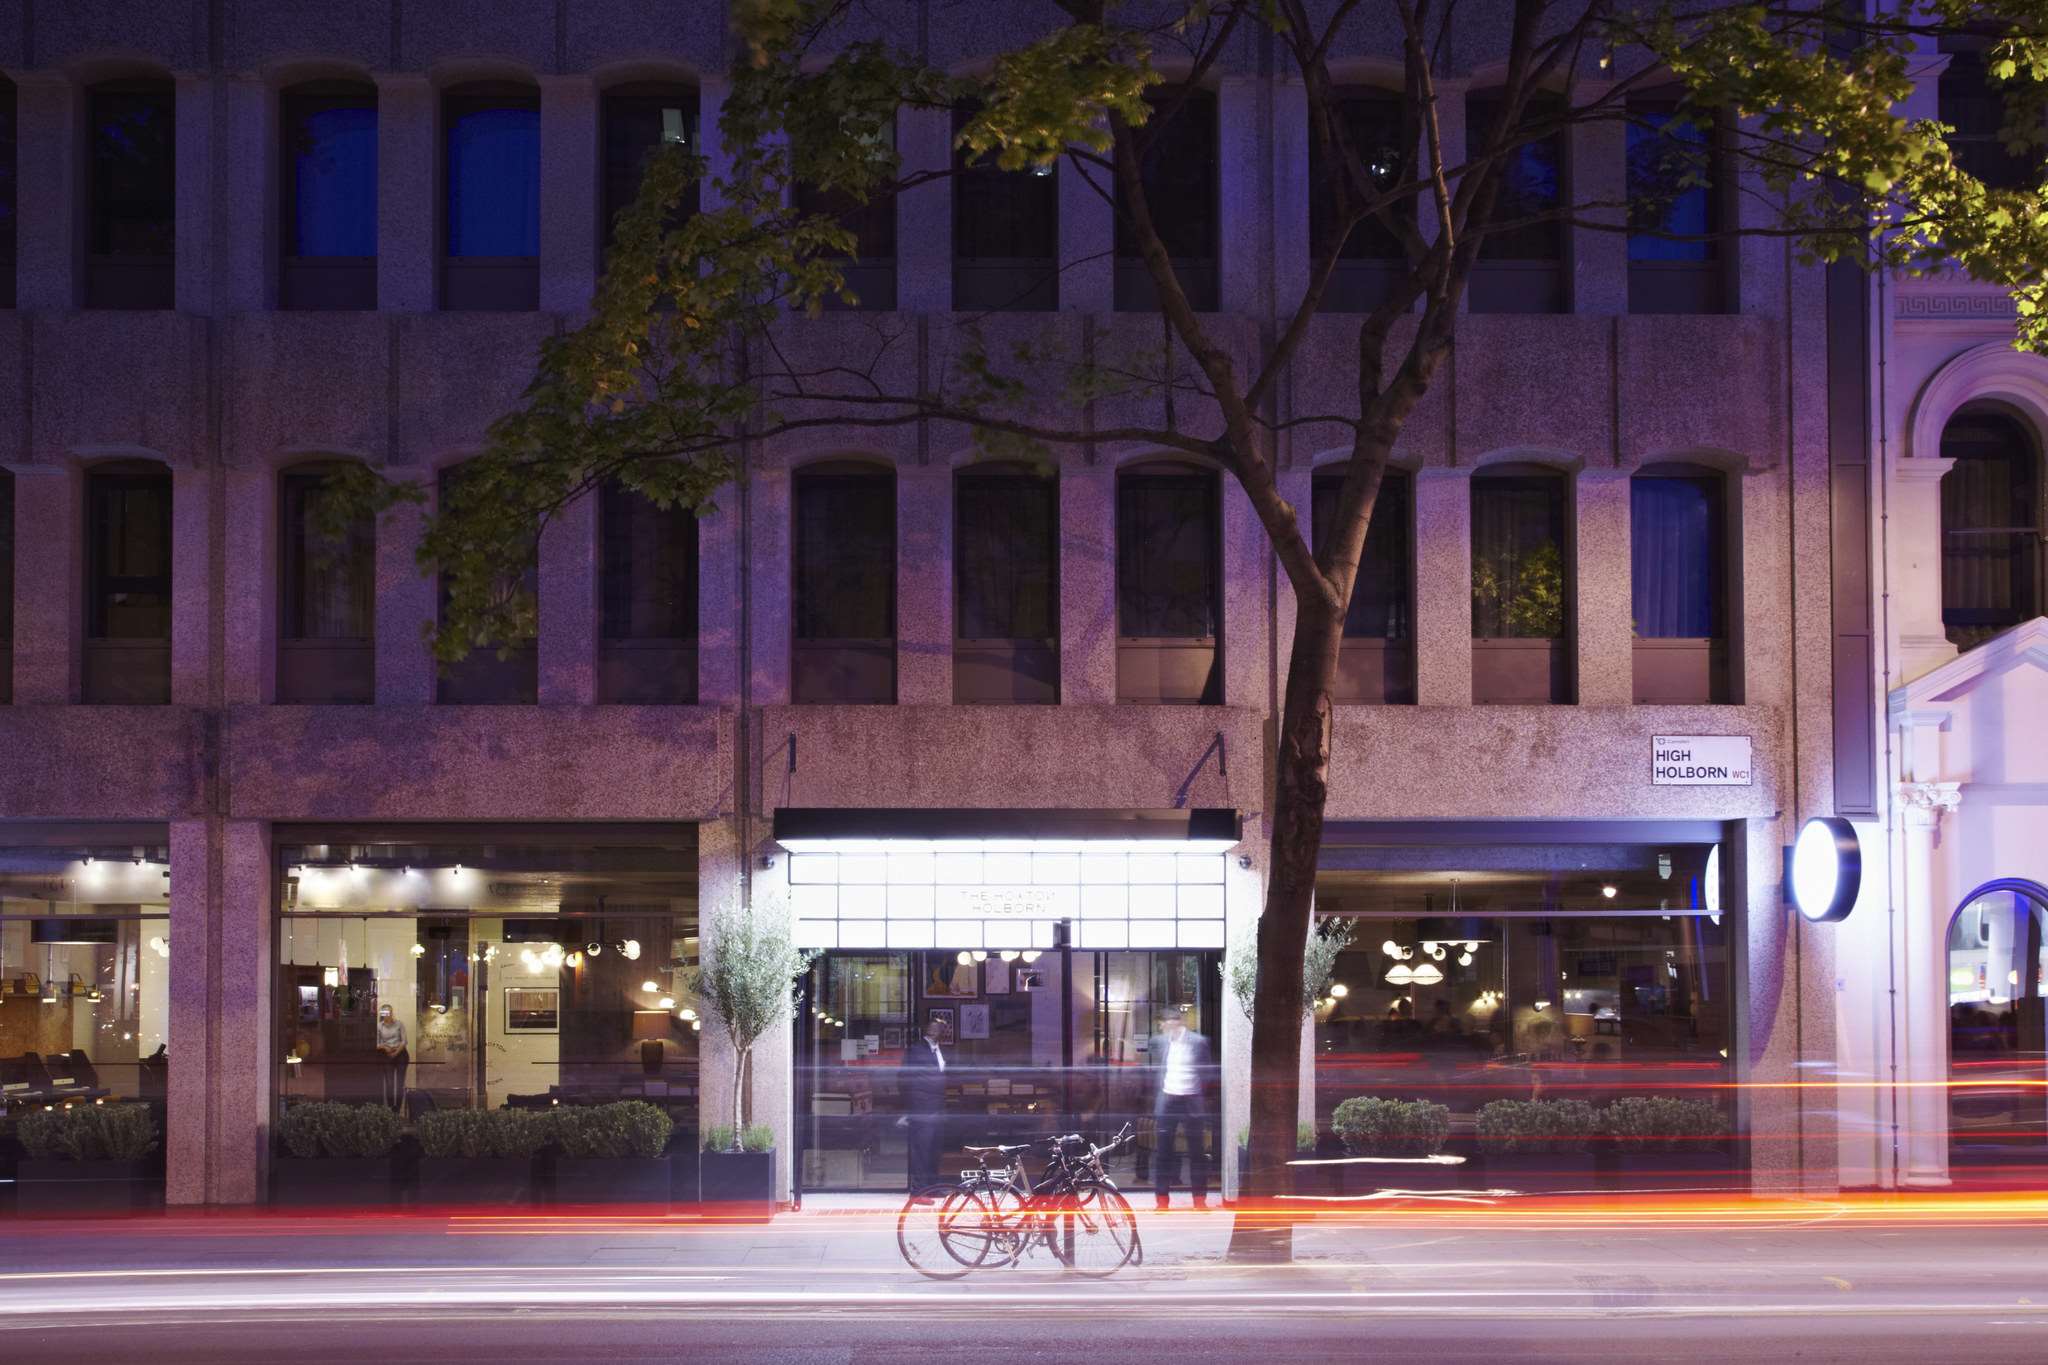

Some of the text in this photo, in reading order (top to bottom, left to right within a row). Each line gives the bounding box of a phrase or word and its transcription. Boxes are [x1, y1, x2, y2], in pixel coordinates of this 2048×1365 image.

[1656, 750, 1691, 762] HIGH
[1656, 766, 1749, 779] HOLBORN WC1
[972, 903, 1046, 913] HOLBORN
